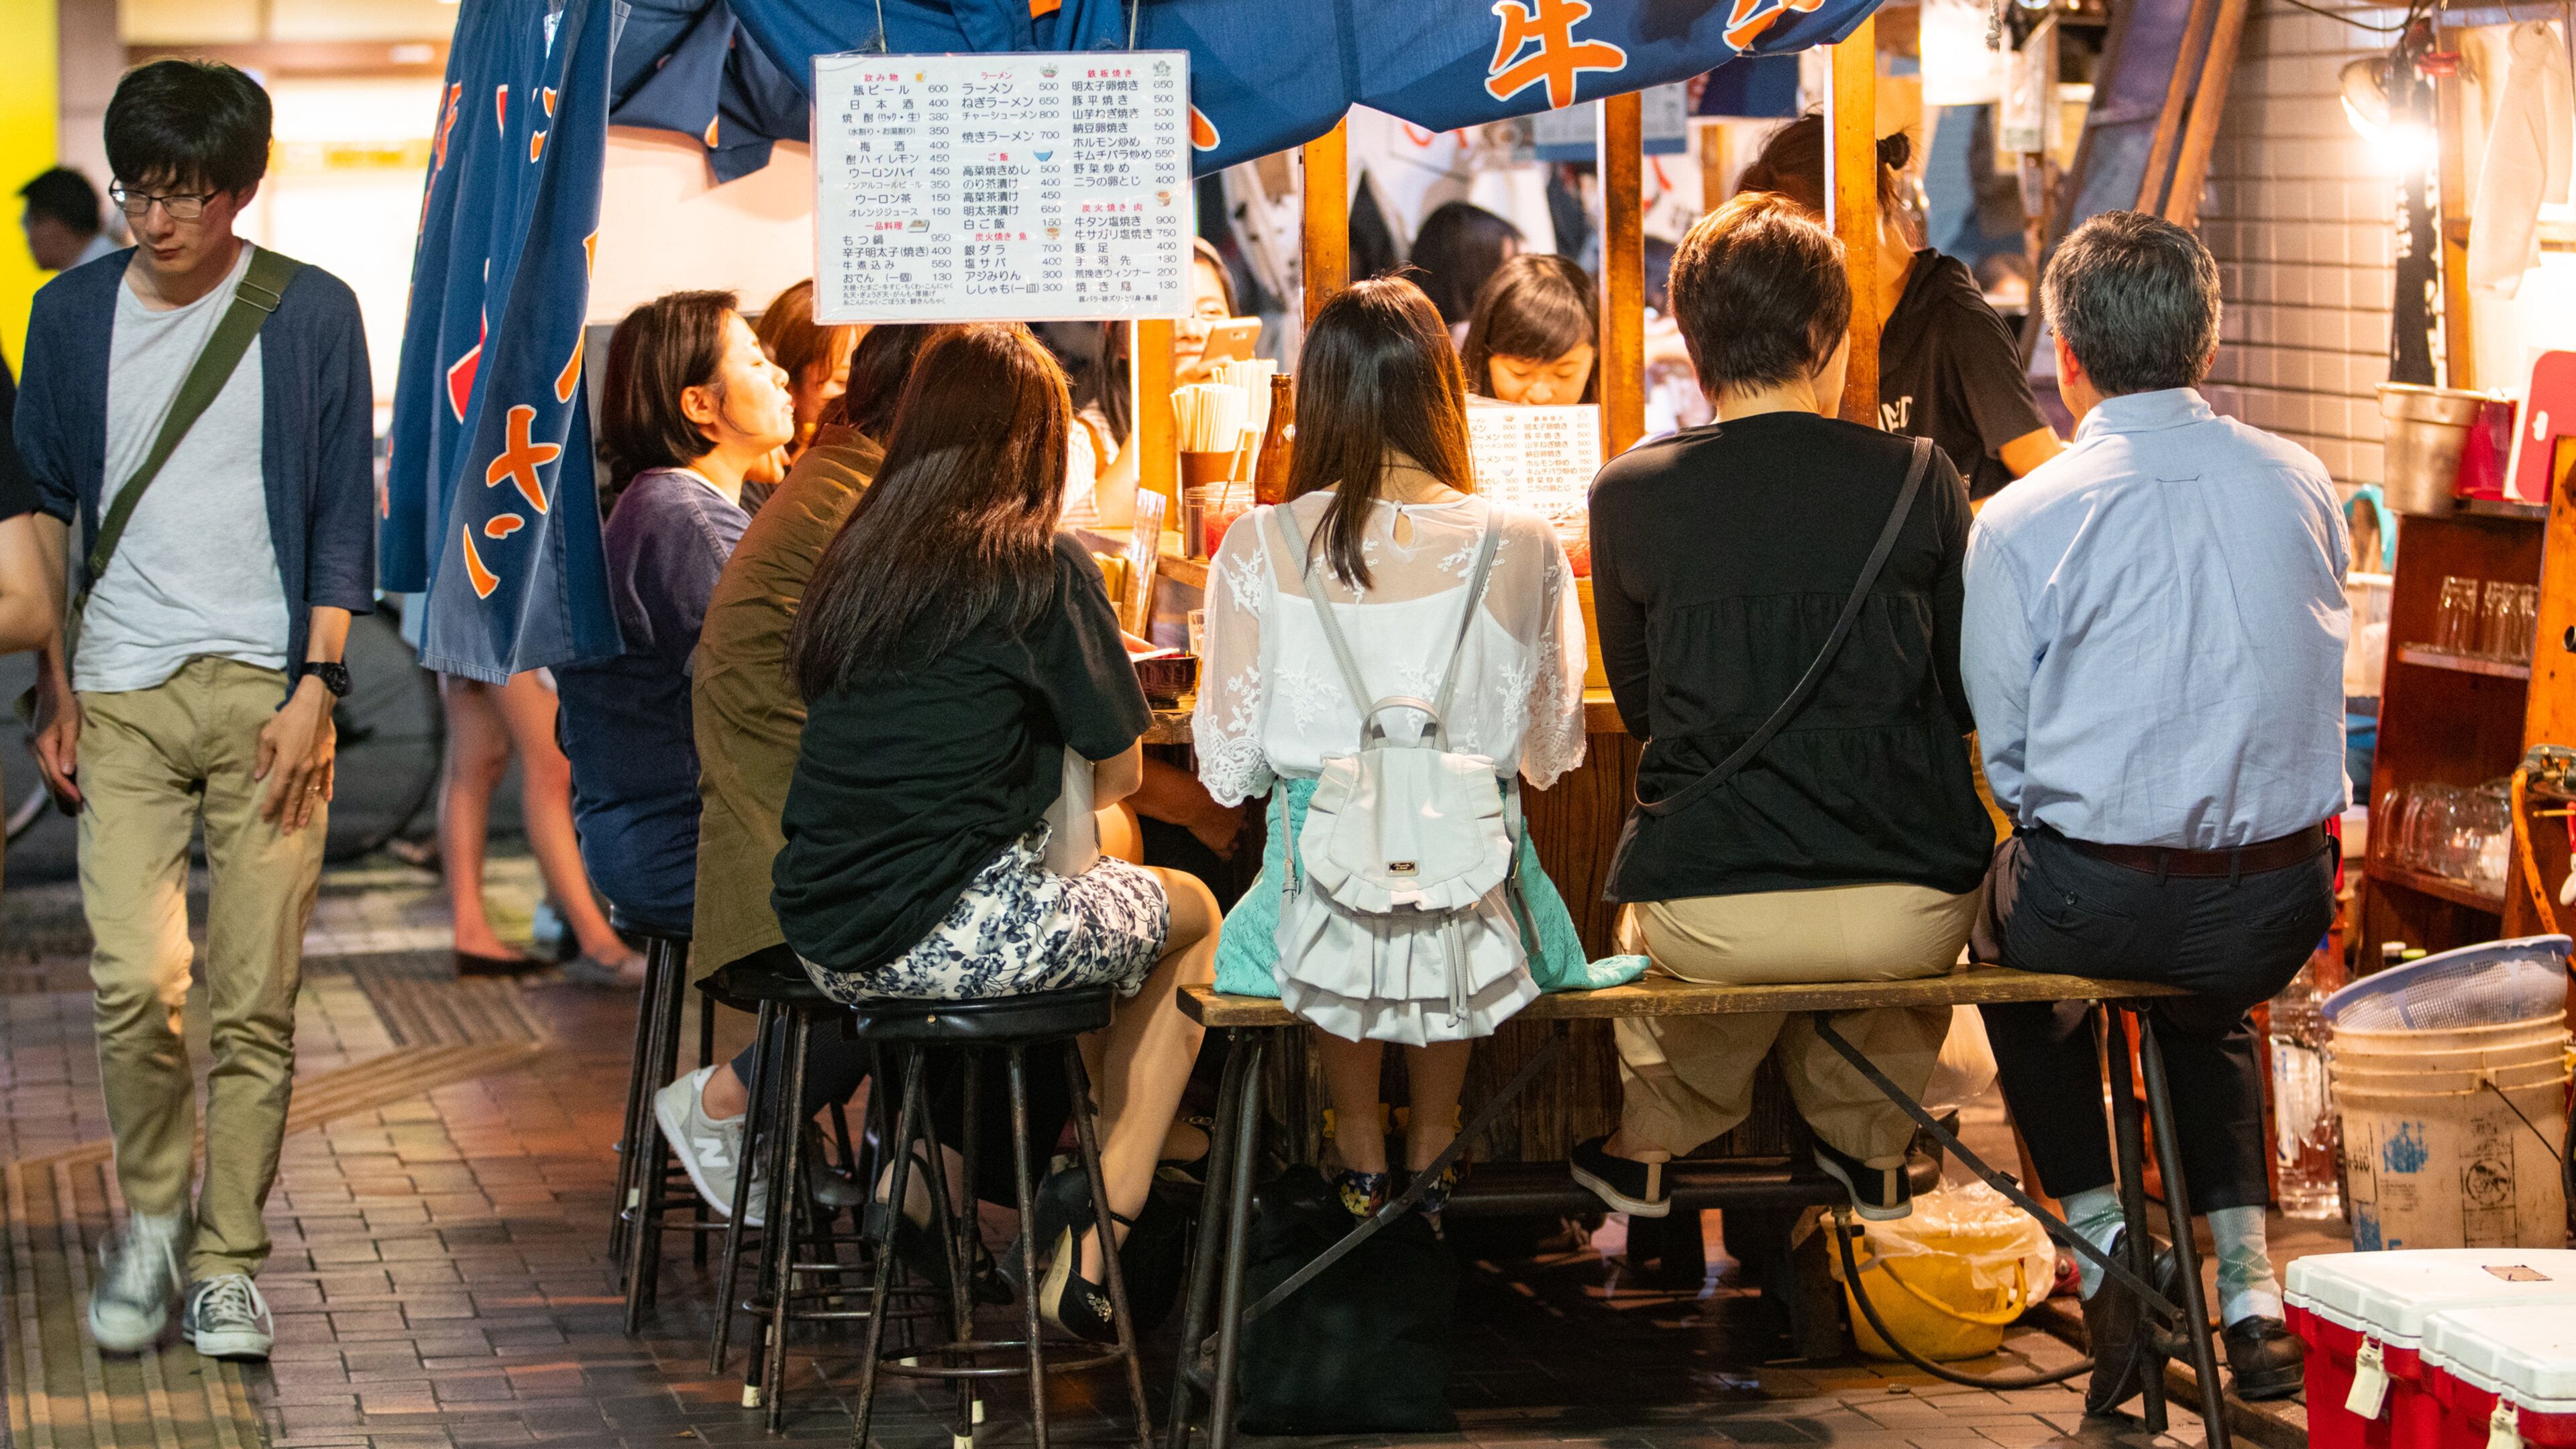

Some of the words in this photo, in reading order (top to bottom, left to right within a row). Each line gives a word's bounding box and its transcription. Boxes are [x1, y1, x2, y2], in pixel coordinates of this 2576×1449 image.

[1485, 0, 1627, 109] 牛
[865, 74, 899, 82] 飲み物
[1087, 69, 1132, 78] 鉄板焼き
[853, 85, 909, 96] 瓶ビール
[963, 83, 1013, 95] ラーメン
[1072, 80, 1138, 91] 明太子卵焼き
[850, 100, 914, 109] 日本酒
[962, 97, 1033, 109] ねぎラーメン
[1039, 97, 1059, 105] 650
[1073, 95, 1128, 106] 豚平焼き
[1155, 95, 1173, 103] 500
[963, 111, 1036, 120] チャーシューメン
[1073, 108, 1138, 119] 山芋ねぎ焼き
[1073, 123, 1128, 133] 納豆卵焼き
[963, 131, 1033, 143] 焼きラーメン
[1073, 137, 1140, 147] ホルモン炒め
[860, 142, 905, 152] 梅酒
[846, 154, 918, 164] 酎ハイレモン
[930, 154, 949, 162] 450
[987, 153, 1009, 161] ご飯
[1074, 150, 1152, 160] キムチバラ炒め
[849, 168, 915, 178] ウーロンハイ
[963, 165, 1030, 176] 高菜焼きめし
[1074, 164, 1130, 174] 野菜炒め
[963, 179, 1018, 189] のり茶漬け
[1075, 176, 1141, 187] ニラの卵とじ
[856, 195, 911, 204] ウーロン茶
[963, 192, 1018, 203] 高菜茶漬け
[849, 208, 918, 217] オレンジジュース
[964, 205, 1019, 216] 明太茶漬け
[865, 221, 902, 230] 一品料理
[964, 219, 1005, 229] 白ご飯
[1075, 216, 1141, 227] 牛タン塩焼き
[1075, 229, 1152, 239] 牛サガリ塩焼き
[843, 235, 884, 245] もつ鍋
[965, 245, 1005, 256] 銀ダラ
[1075, 242, 1108, 253] 豚足
[843, 248, 928, 258] 辛子明太子(焼き)
[843, 260, 895, 270] 牛煮込み
[965, 258, 1006, 268] 塩サバ
[1075, 256, 1131, 266] 手羽先
[843, 274, 874, 283] おでん
[965, 271, 1020, 281] アジみりん
[1075, 269, 1150, 278] 荒挽きウィンナー
[1076, 280, 1132, 292] 焼き鳥
